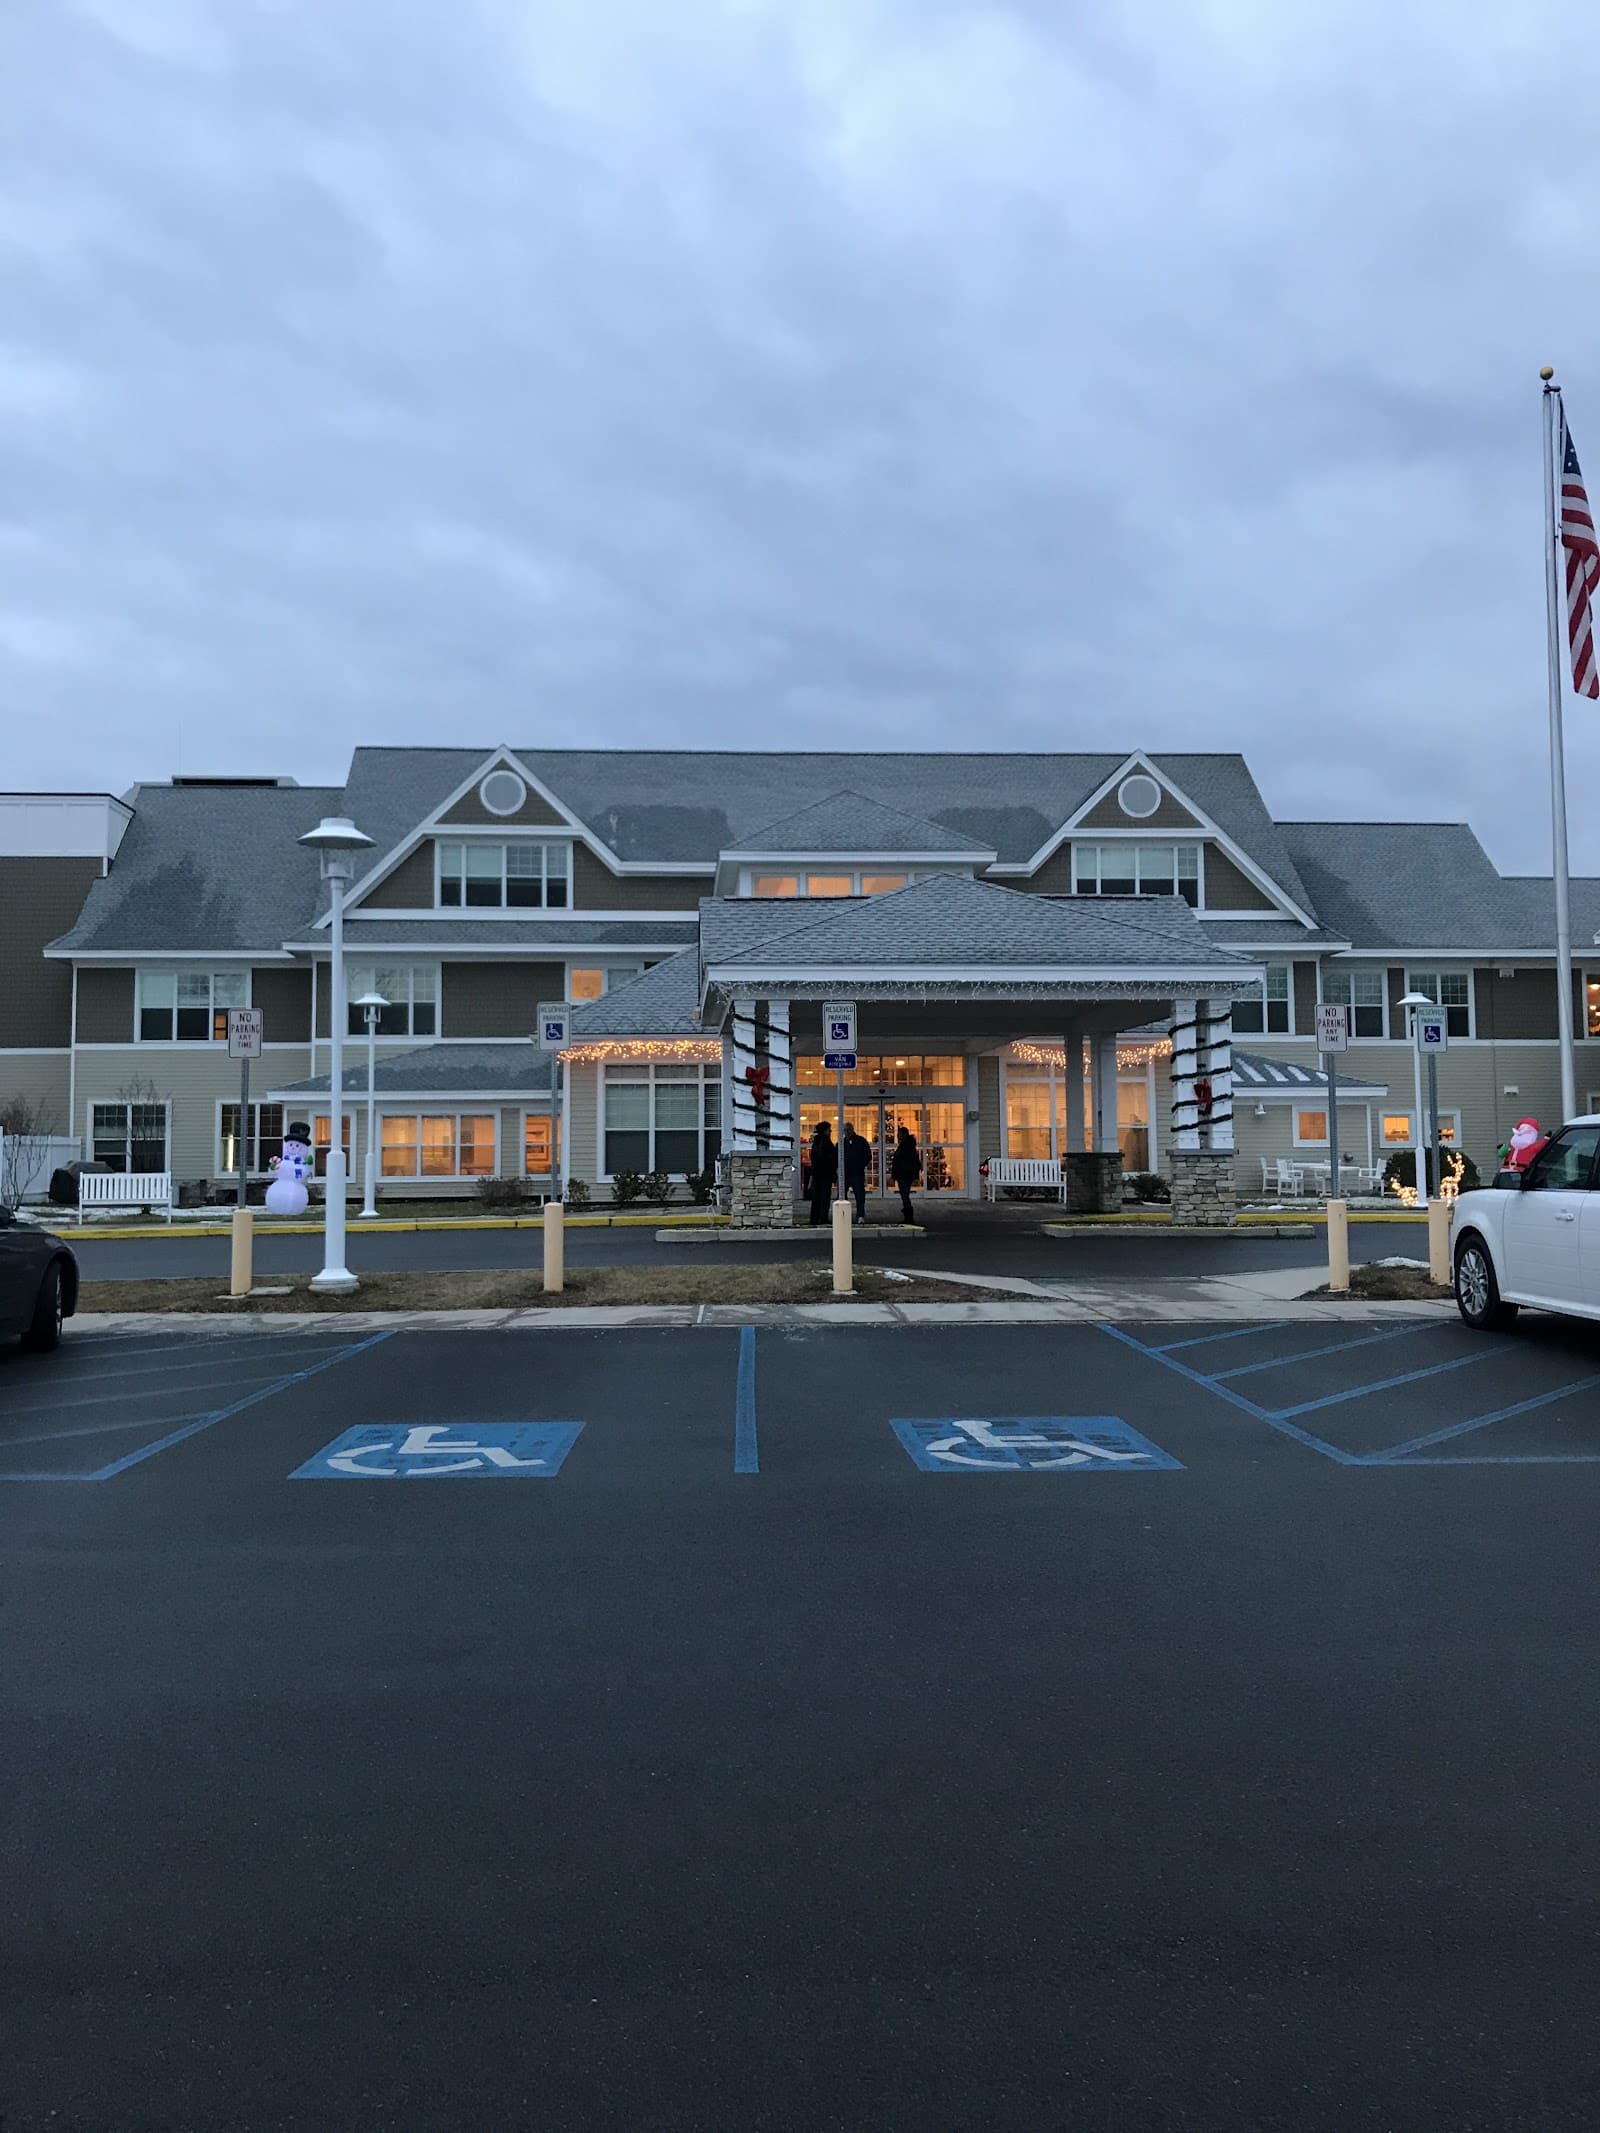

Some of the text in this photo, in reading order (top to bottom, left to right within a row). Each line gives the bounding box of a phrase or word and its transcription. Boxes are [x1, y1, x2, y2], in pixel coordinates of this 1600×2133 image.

[825, 1005, 854, 1013] RESERVED
[1325, 1007, 1337, 1017] NO
[239, 1012, 252, 1023] NO
[1317, 1018, 1345, 1028] PARKING
[231, 1023, 260, 1034] PARKING
[238, 1041, 252, 1049] TIME
